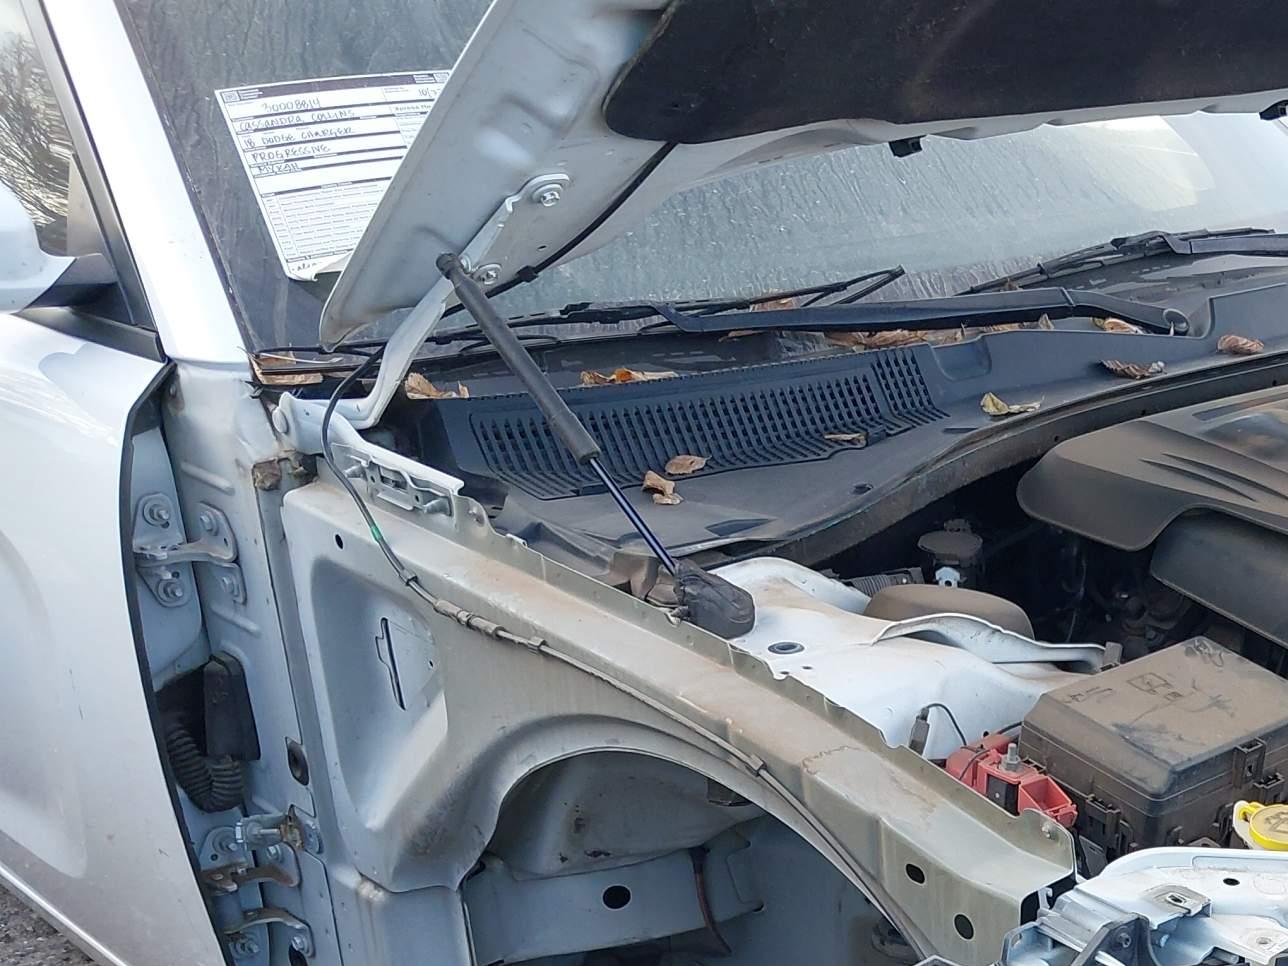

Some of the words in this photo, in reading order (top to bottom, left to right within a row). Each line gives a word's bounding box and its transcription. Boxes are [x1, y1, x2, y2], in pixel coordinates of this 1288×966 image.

[239, 115, 305, 132] CASSANDRA
[311, 109, 355, 122] COLLINS
[243, 137, 256, 149] 18
[261, 134, 296, 146] DODGE
[301, 126, 353, 140] CHARGER
[251, 143, 331, 162] PROGRESSIVE
